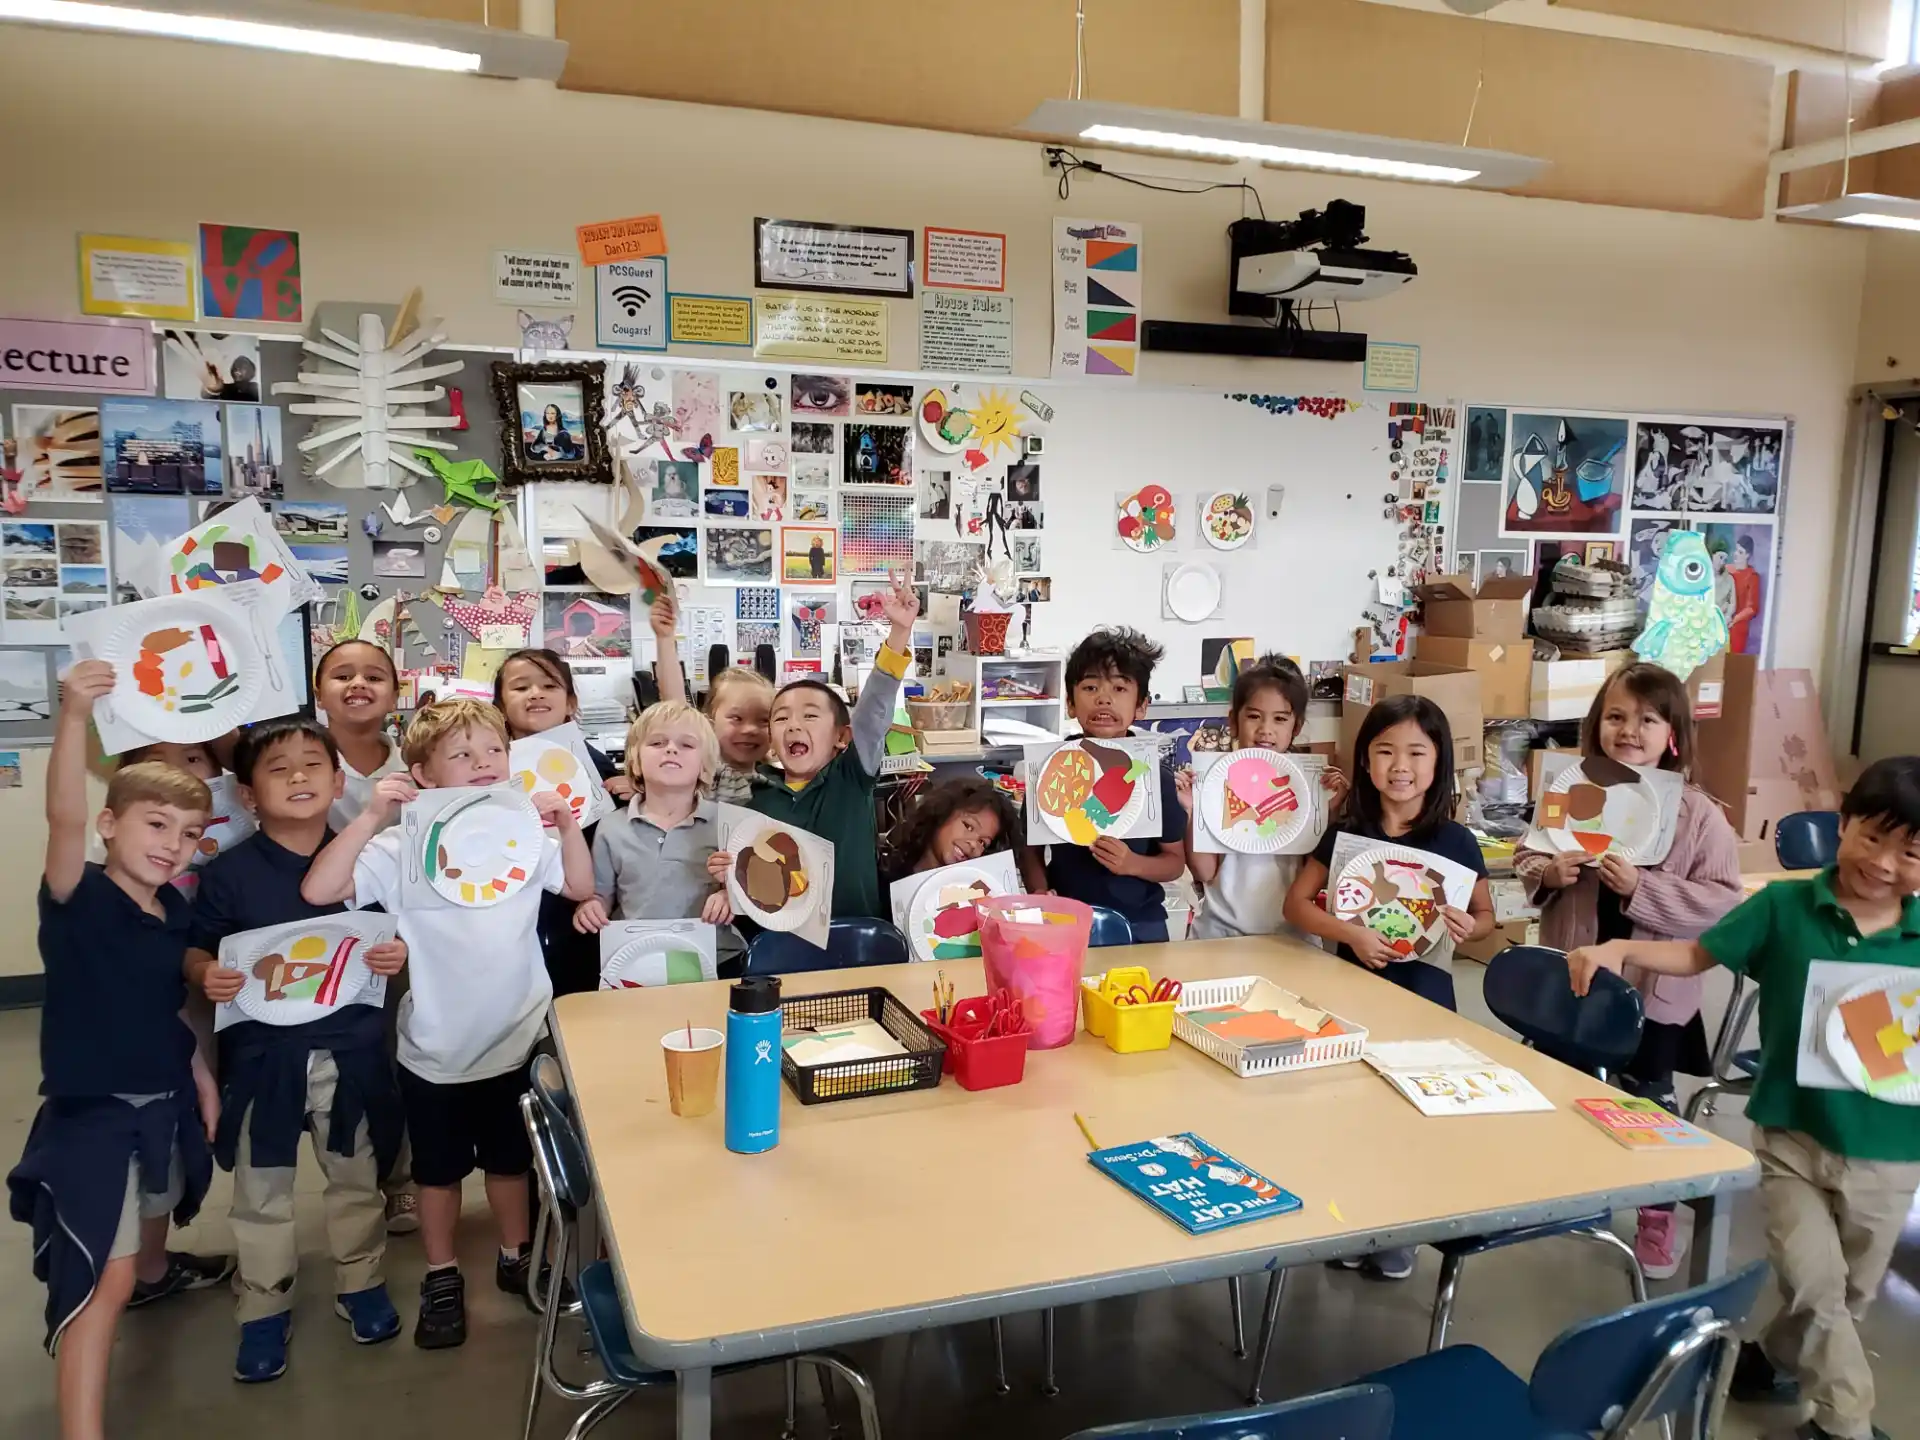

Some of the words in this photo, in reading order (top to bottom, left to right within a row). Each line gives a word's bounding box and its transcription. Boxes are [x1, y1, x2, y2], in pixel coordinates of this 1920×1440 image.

[609, 265, 653, 278] PCSGuest
[934, 293, 969, 311] House
[972, 296, 1002, 313] Rules
[612, 323, 652, 338] Cougars!
[0, 348, 130, 377] ecture
[1148, 1176, 1206, 1197] HAT
[1172, 1190, 1207, 1201] THE
[1189, 1198, 1210, 1208] IN
[1240, 1198, 1278, 1208] THE
[1189, 1202, 1243, 1223] CAT
